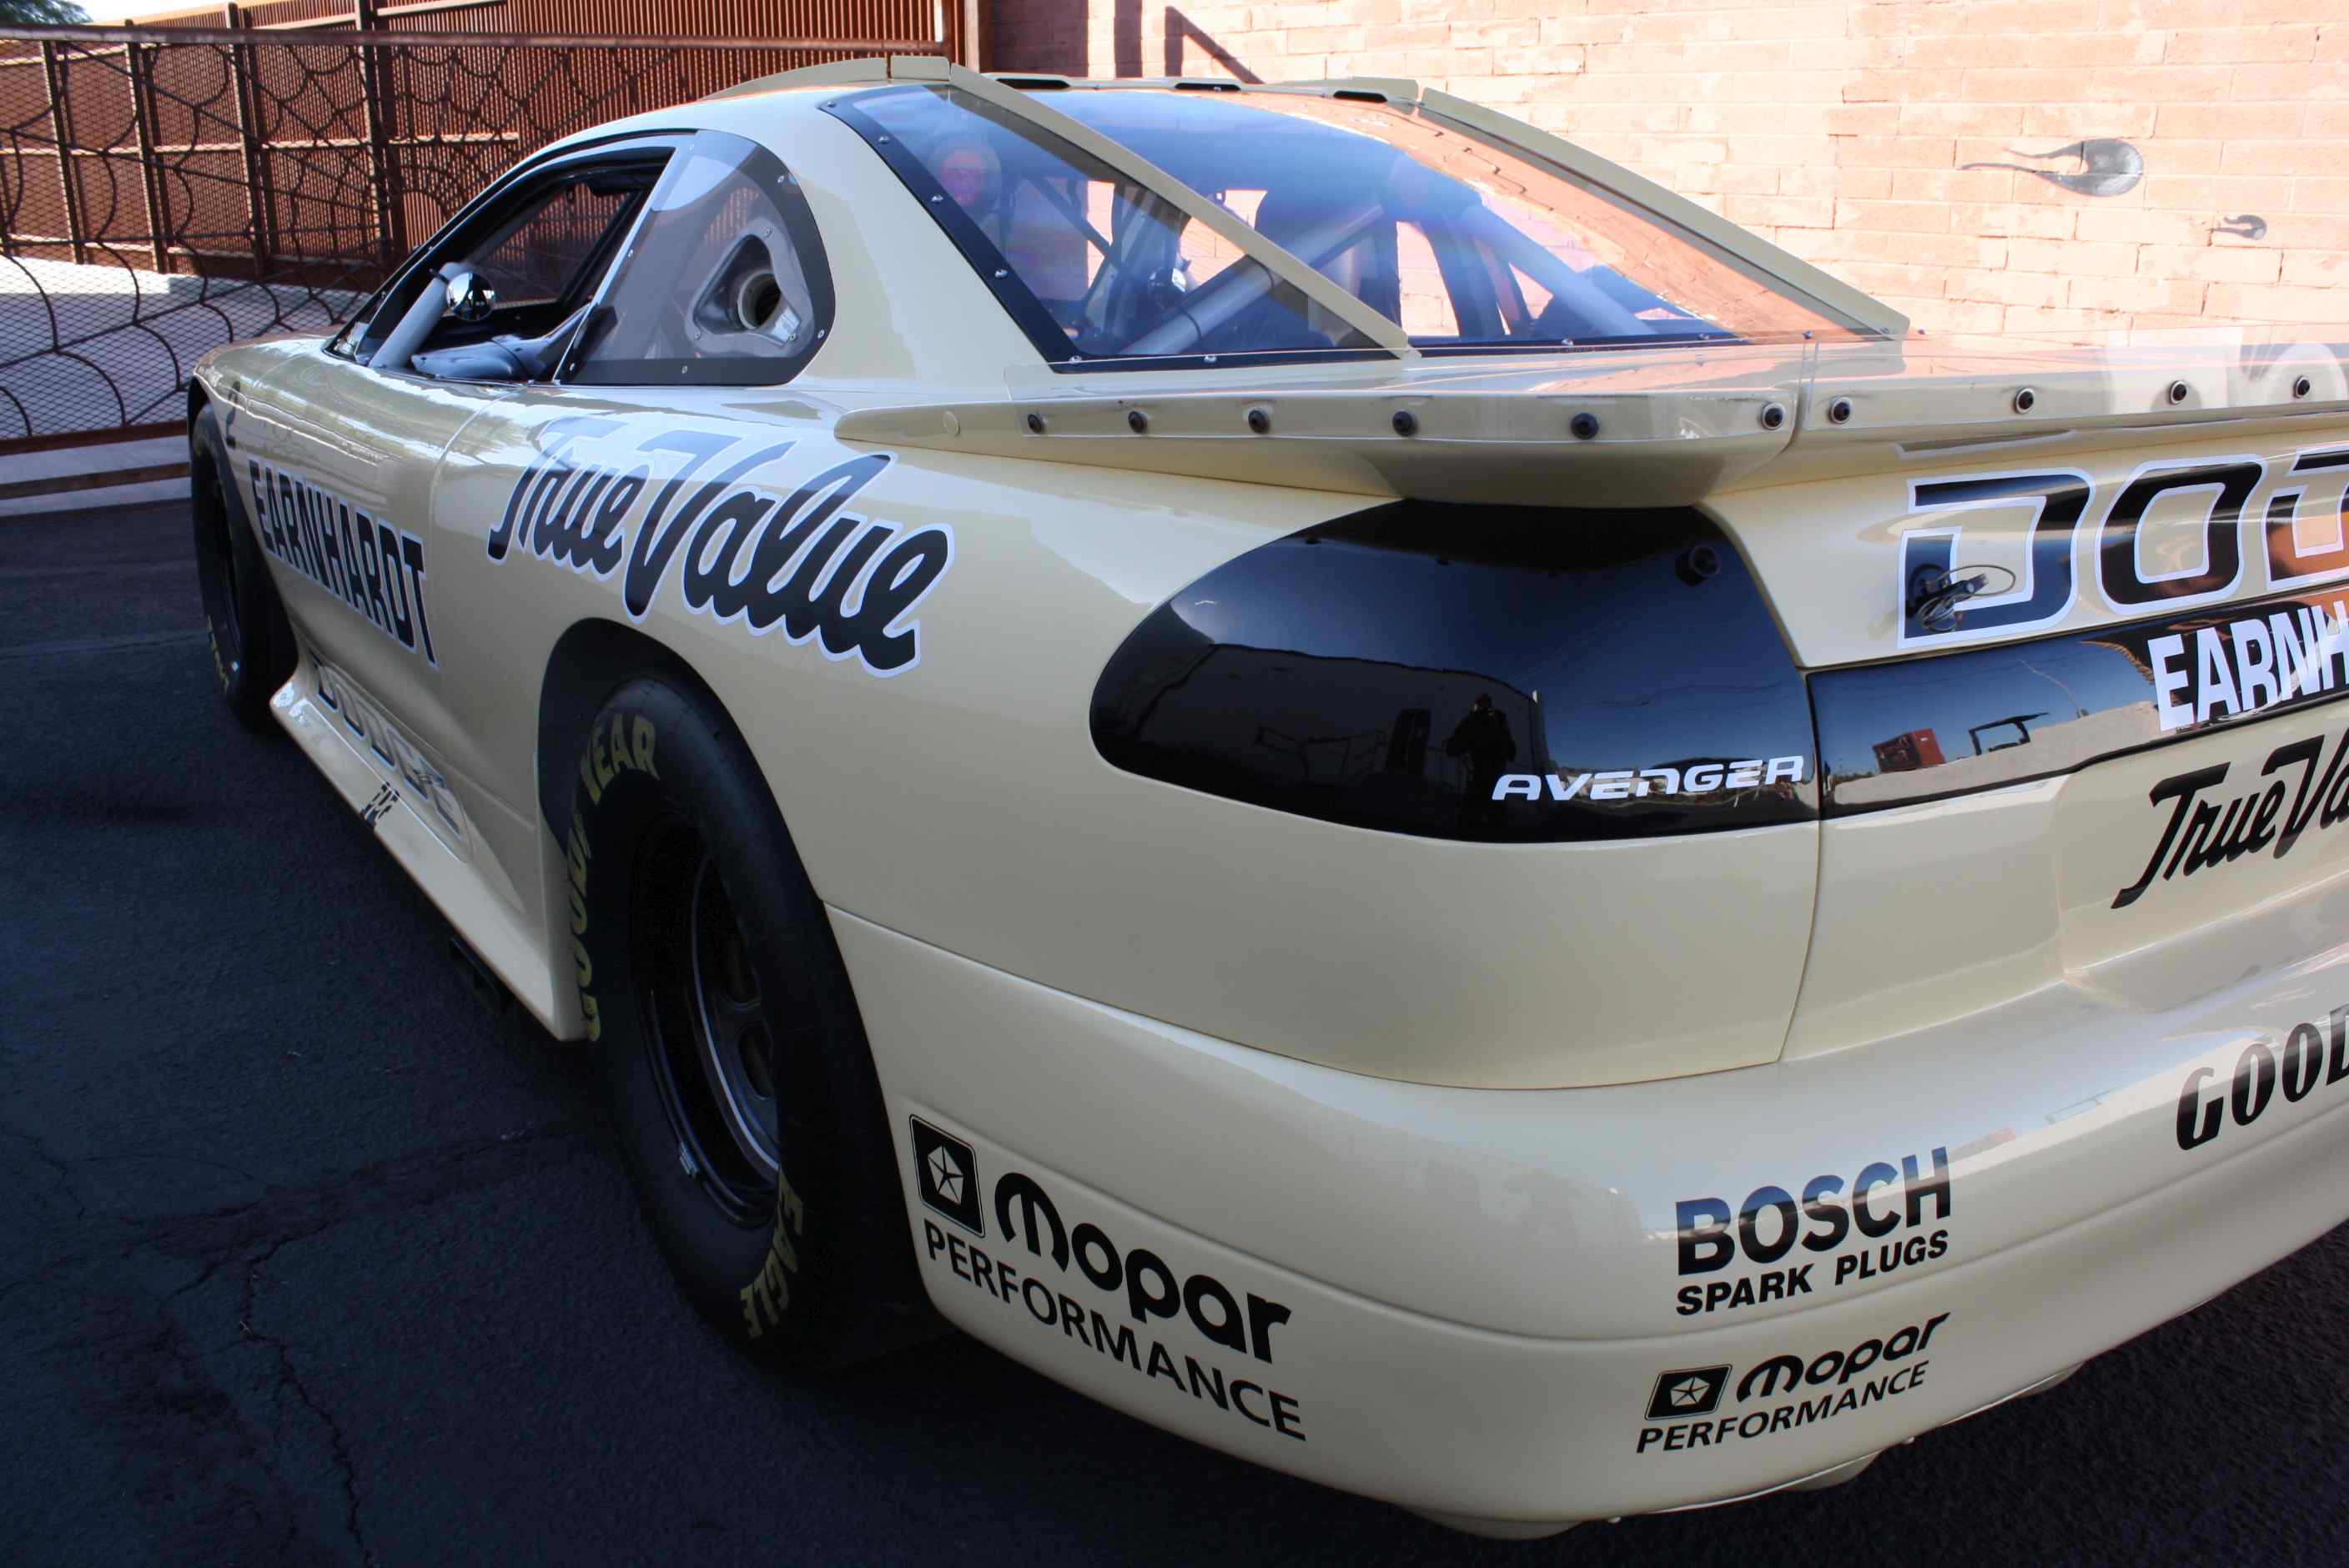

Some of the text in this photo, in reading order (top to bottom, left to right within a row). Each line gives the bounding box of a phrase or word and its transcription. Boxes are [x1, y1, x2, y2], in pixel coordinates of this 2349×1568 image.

[248, 456, 439, 670] EARNHARDT
[487, 416, 954, 678] True Value
[2148, 601, 2349, 731] EARNH
[2110, 761, 2286, 908] True
[740, 1168, 803, 1339] EAGLE
[1676, 1147, 1950, 1275] BOSCH
[1676, 1230, 1948, 1315] SPARK PLUGS
[924, 1218, 1306, 1441] PERFORMANCE
[1636, 1359, 1930, 1454] PERFORMANCE
